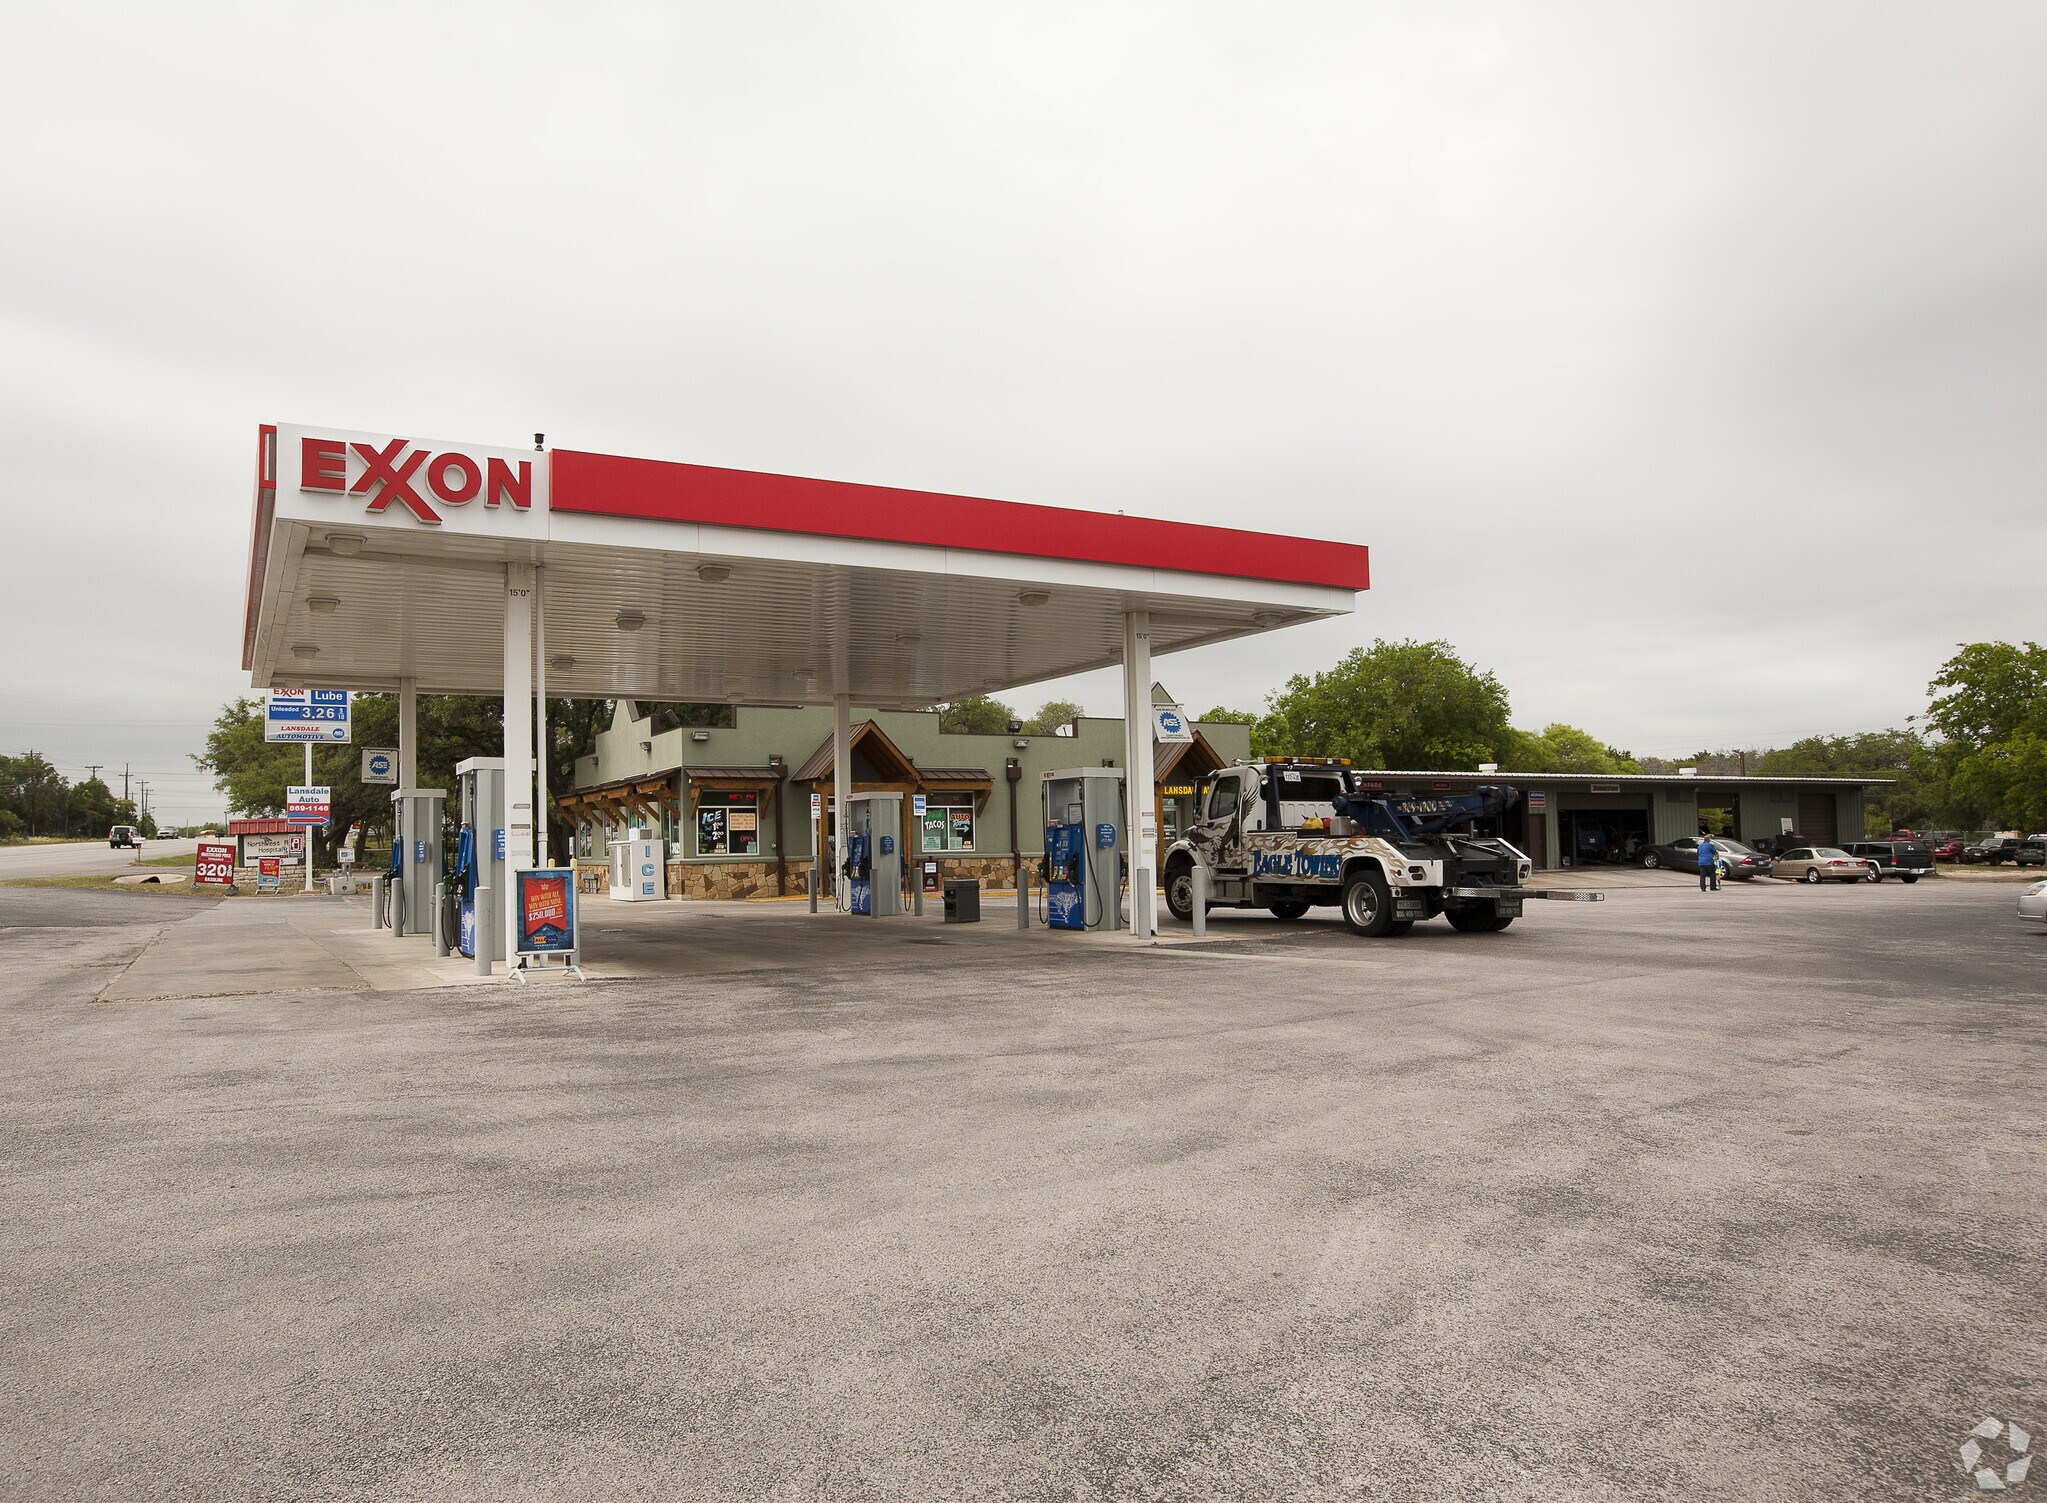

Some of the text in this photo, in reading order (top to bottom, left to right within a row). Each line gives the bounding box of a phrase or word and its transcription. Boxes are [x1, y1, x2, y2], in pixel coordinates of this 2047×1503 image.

[300, 437, 533, 525] EXXON
[509, 588, 530, 597] 15'0"
[315, 691, 343, 700] Lube
[302, 707, 334, 719] 3.26
[1164, 786, 1194, 794] LANSDA
[702, 810, 722, 824] ICE
[925, 820, 945, 830] TACOS
[197, 863, 227, 877] 320
[642, 845, 655, 895] ICE
